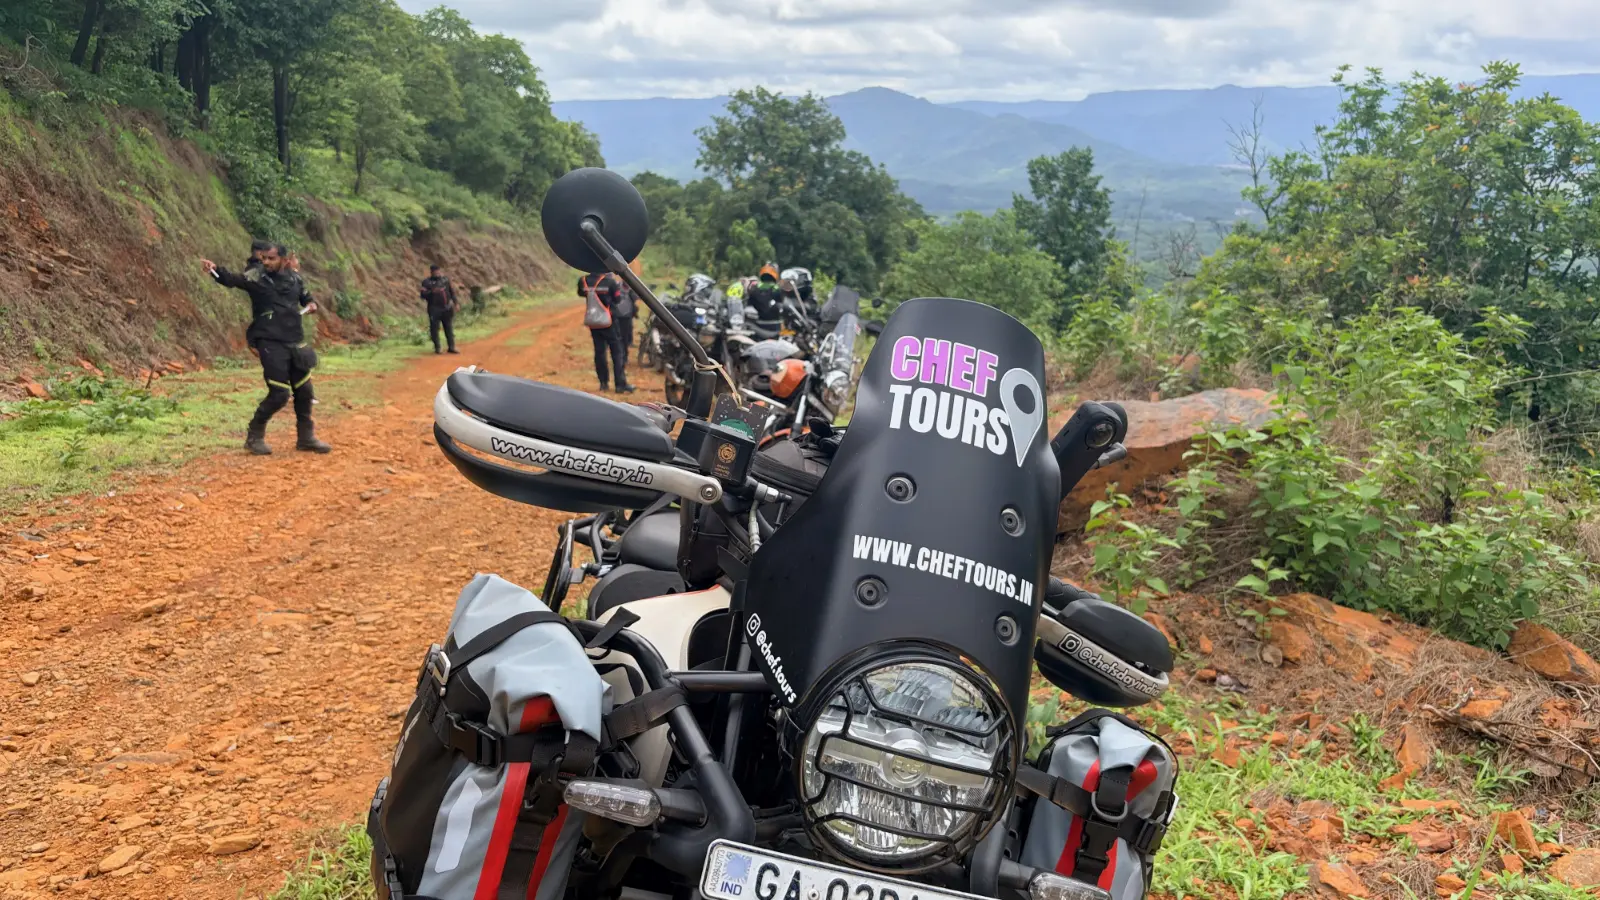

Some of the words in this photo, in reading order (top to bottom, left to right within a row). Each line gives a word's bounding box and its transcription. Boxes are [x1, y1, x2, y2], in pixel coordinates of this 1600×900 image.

[890, 335, 999, 398] CHEF
[888, 384, 1009, 456] TOURS
[491, 436, 654, 484] www.chefsday.in
[852, 534, 1034, 607] WWW.CHEFTOURS.IN
[756, 630, 797, 704] @chef.tours
[1078, 646, 1161, 698] @chefsdayindia
[720, 881, 742, 896] IND
